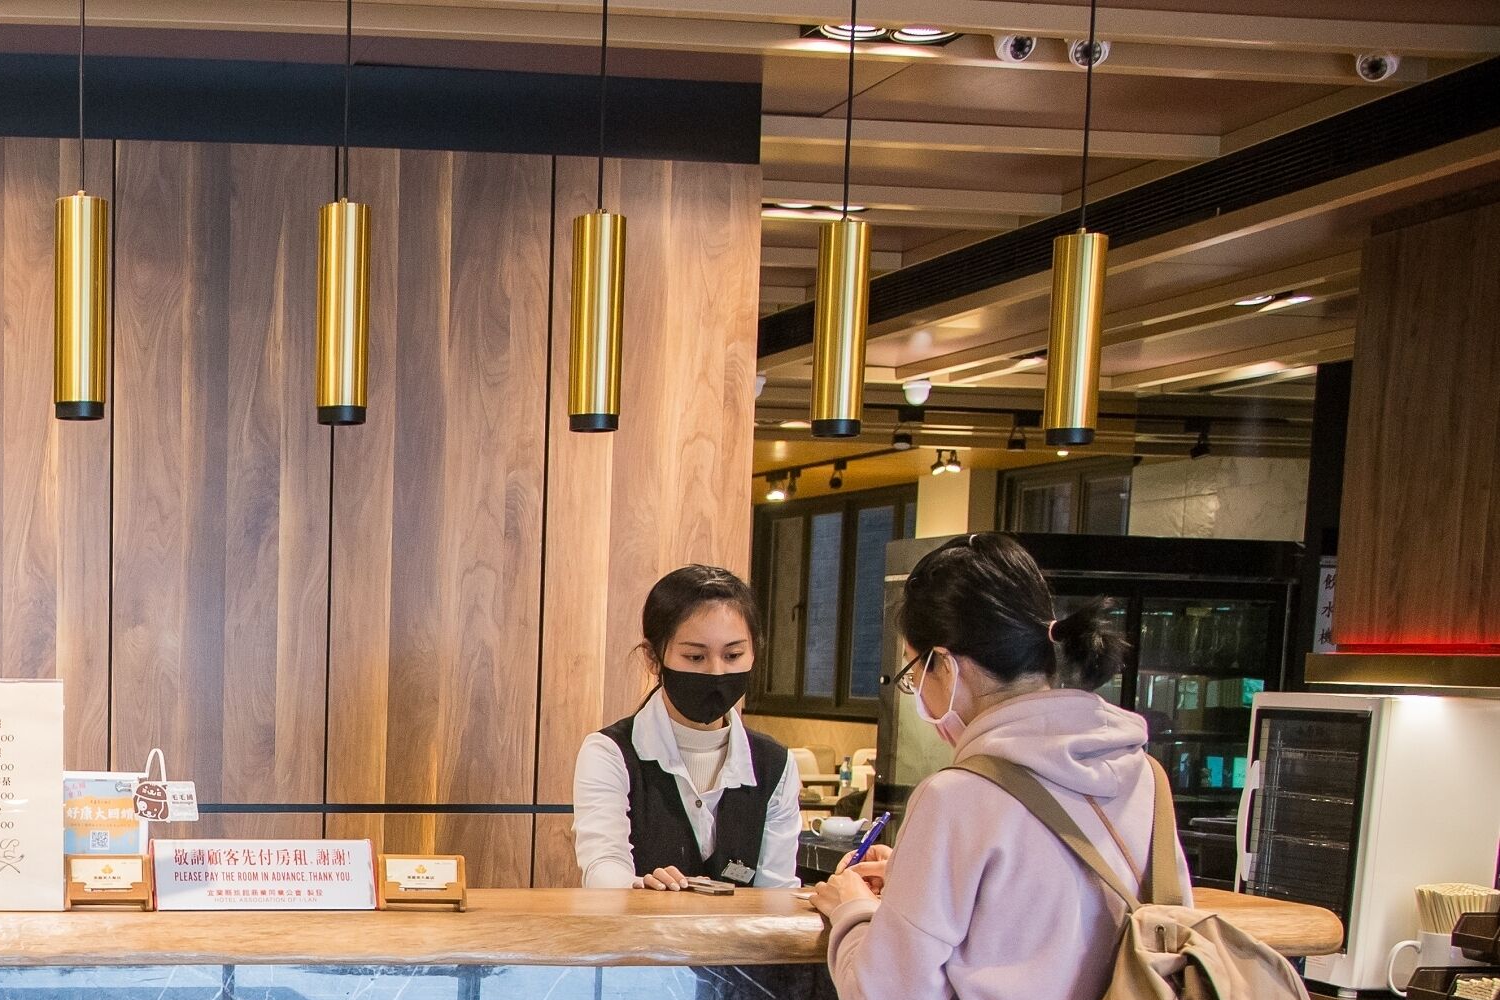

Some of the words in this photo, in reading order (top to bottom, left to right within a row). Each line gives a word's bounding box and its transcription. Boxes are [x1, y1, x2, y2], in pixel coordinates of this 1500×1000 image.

[174, 872, 202, 882] PLEASE
[204, 872, 219, 882] PAY
[222, 872, 235, 882] THE
[237, 872, 259, 882] ROOM
[261, 872, 269, 882] IN
